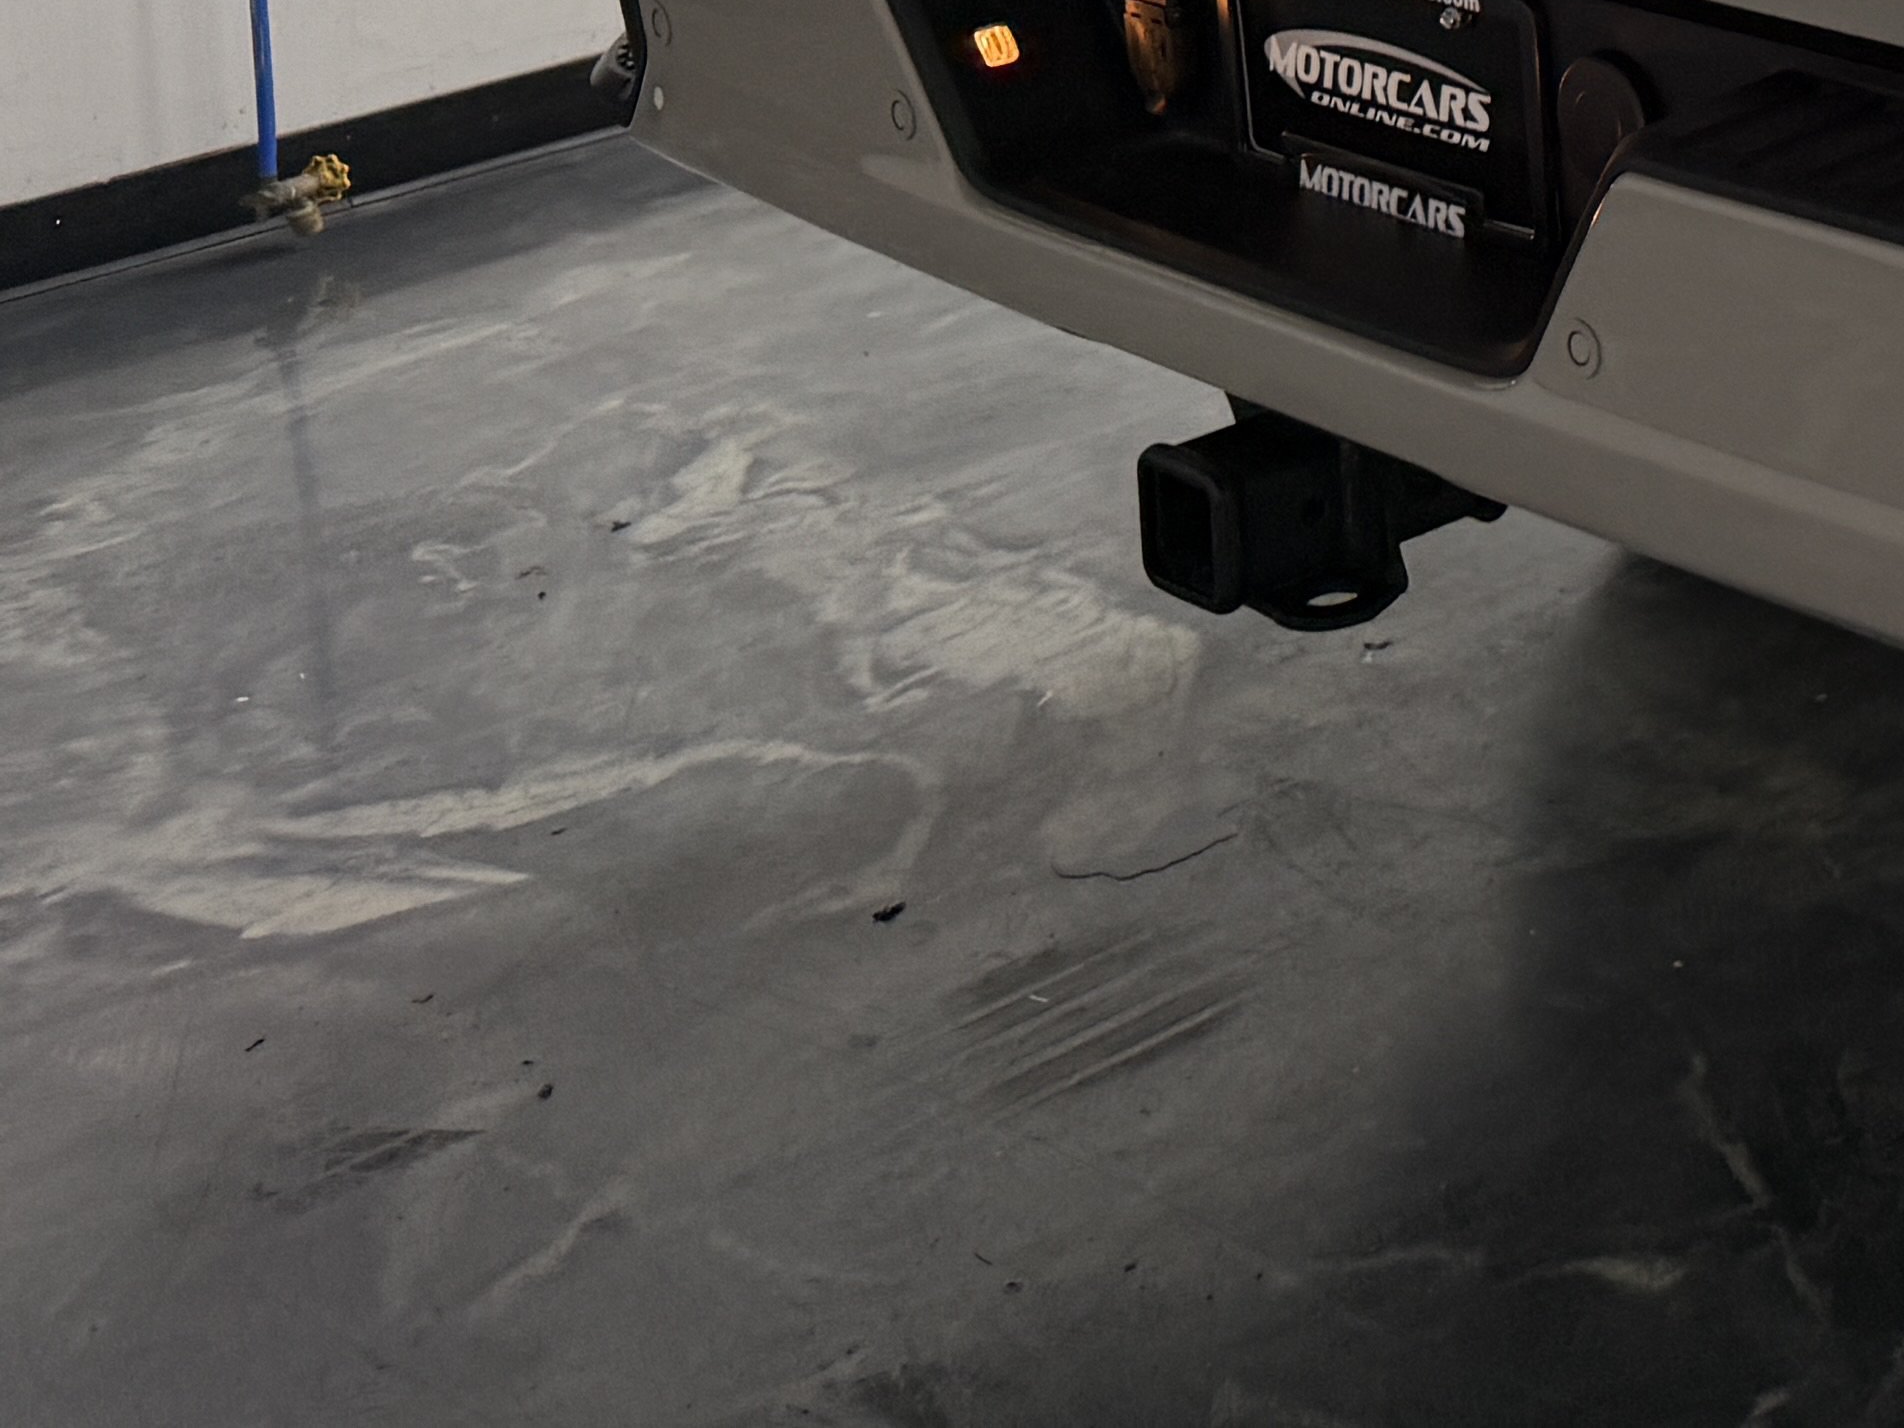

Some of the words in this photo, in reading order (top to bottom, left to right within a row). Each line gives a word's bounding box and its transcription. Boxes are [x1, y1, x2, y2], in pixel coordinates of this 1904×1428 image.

[1268, 34, 1491, 133] MOTORCARS
[1310, 91, 1490, 153] ONLINE.COM
[1300, 158, 1466, 239] MOTORCARS
